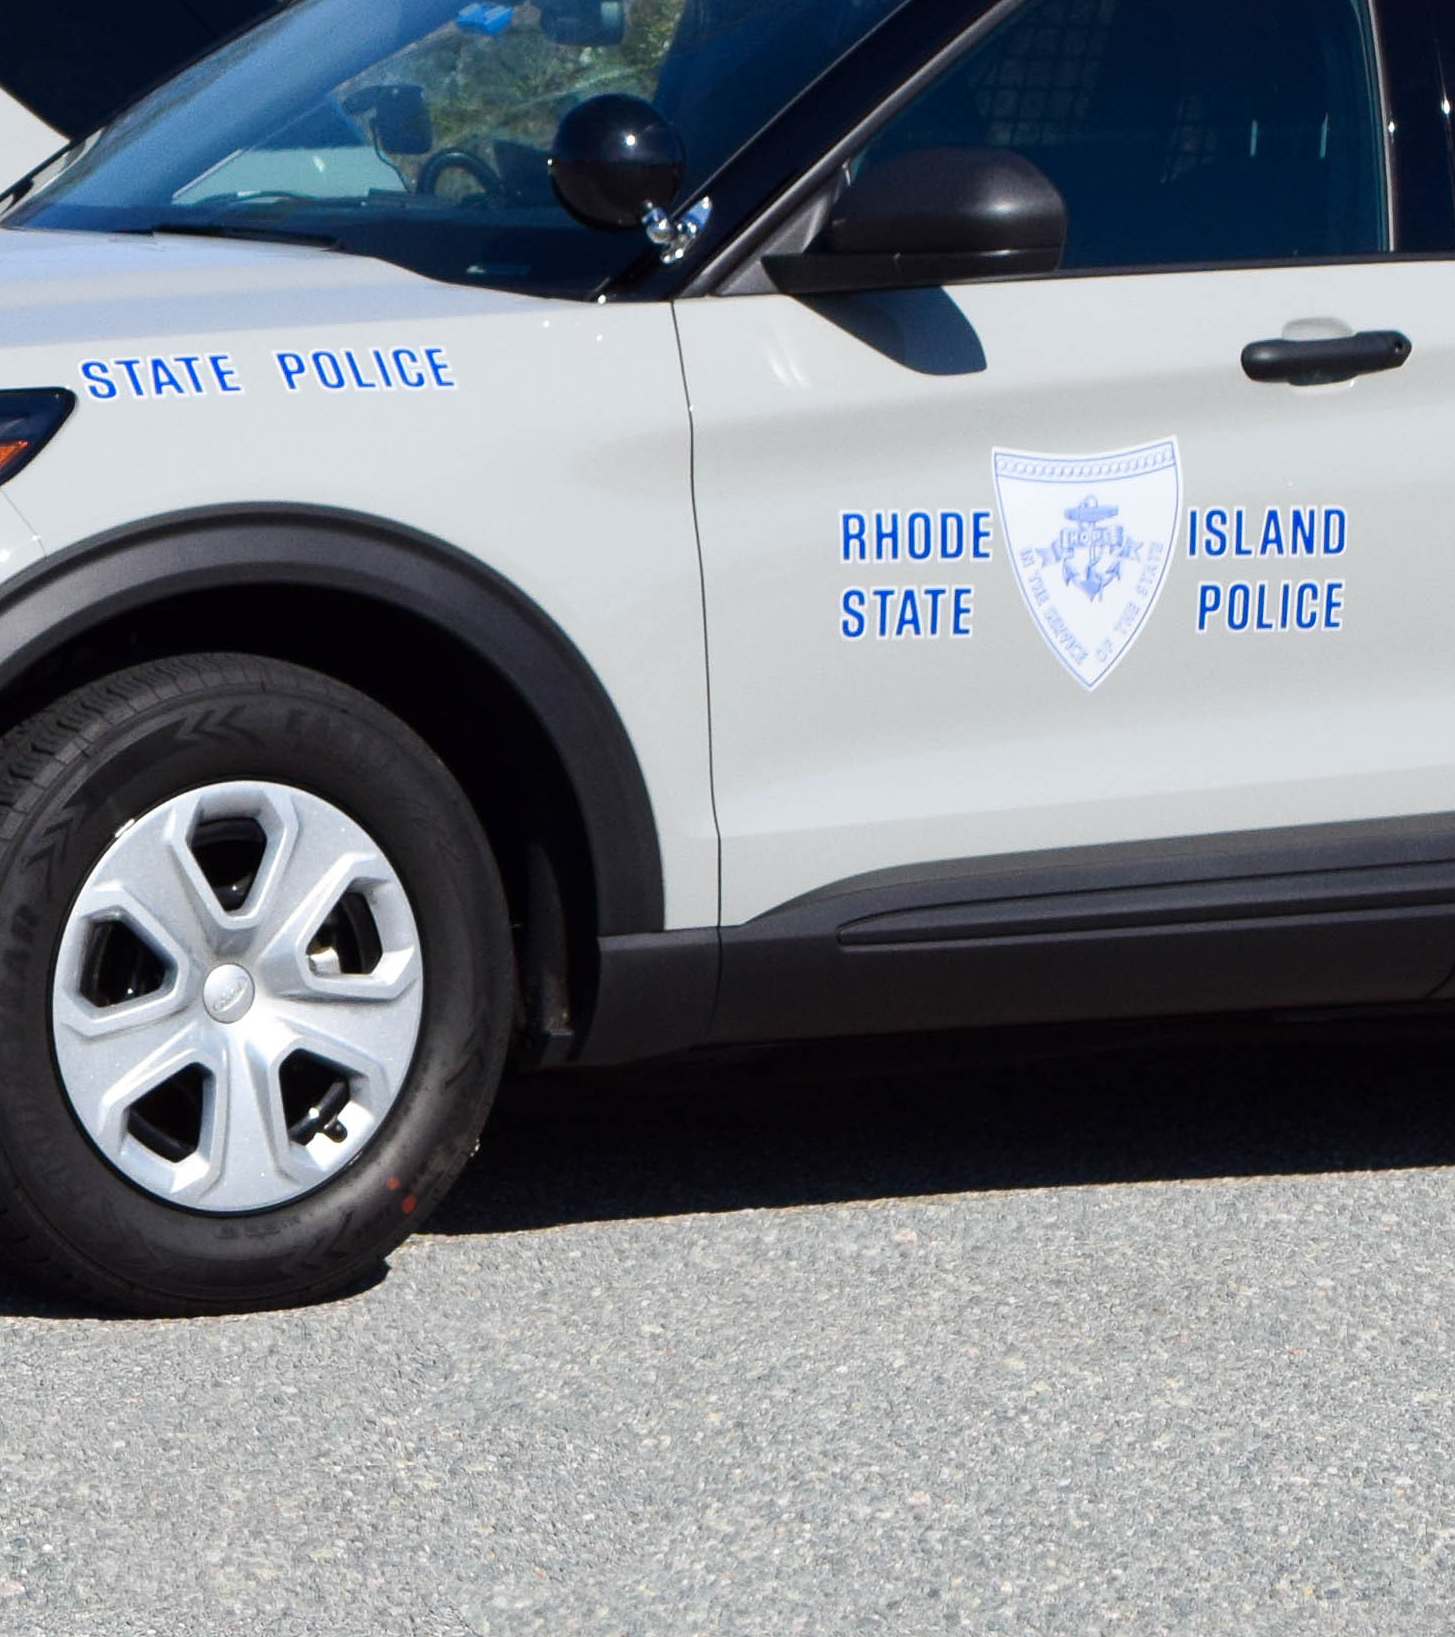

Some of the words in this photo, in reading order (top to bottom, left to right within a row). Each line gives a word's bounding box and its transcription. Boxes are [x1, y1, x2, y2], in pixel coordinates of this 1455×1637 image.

[81, 354, 242, 400] STATE
[276, 347, 456, 391] POLICE
[842, 510, 993, 562] RHODE
[1188, 508, 1348, 559] ISLAND
[842, 587, 974, 639] STATE
[1198, 582, 1344, 633] POLICE
